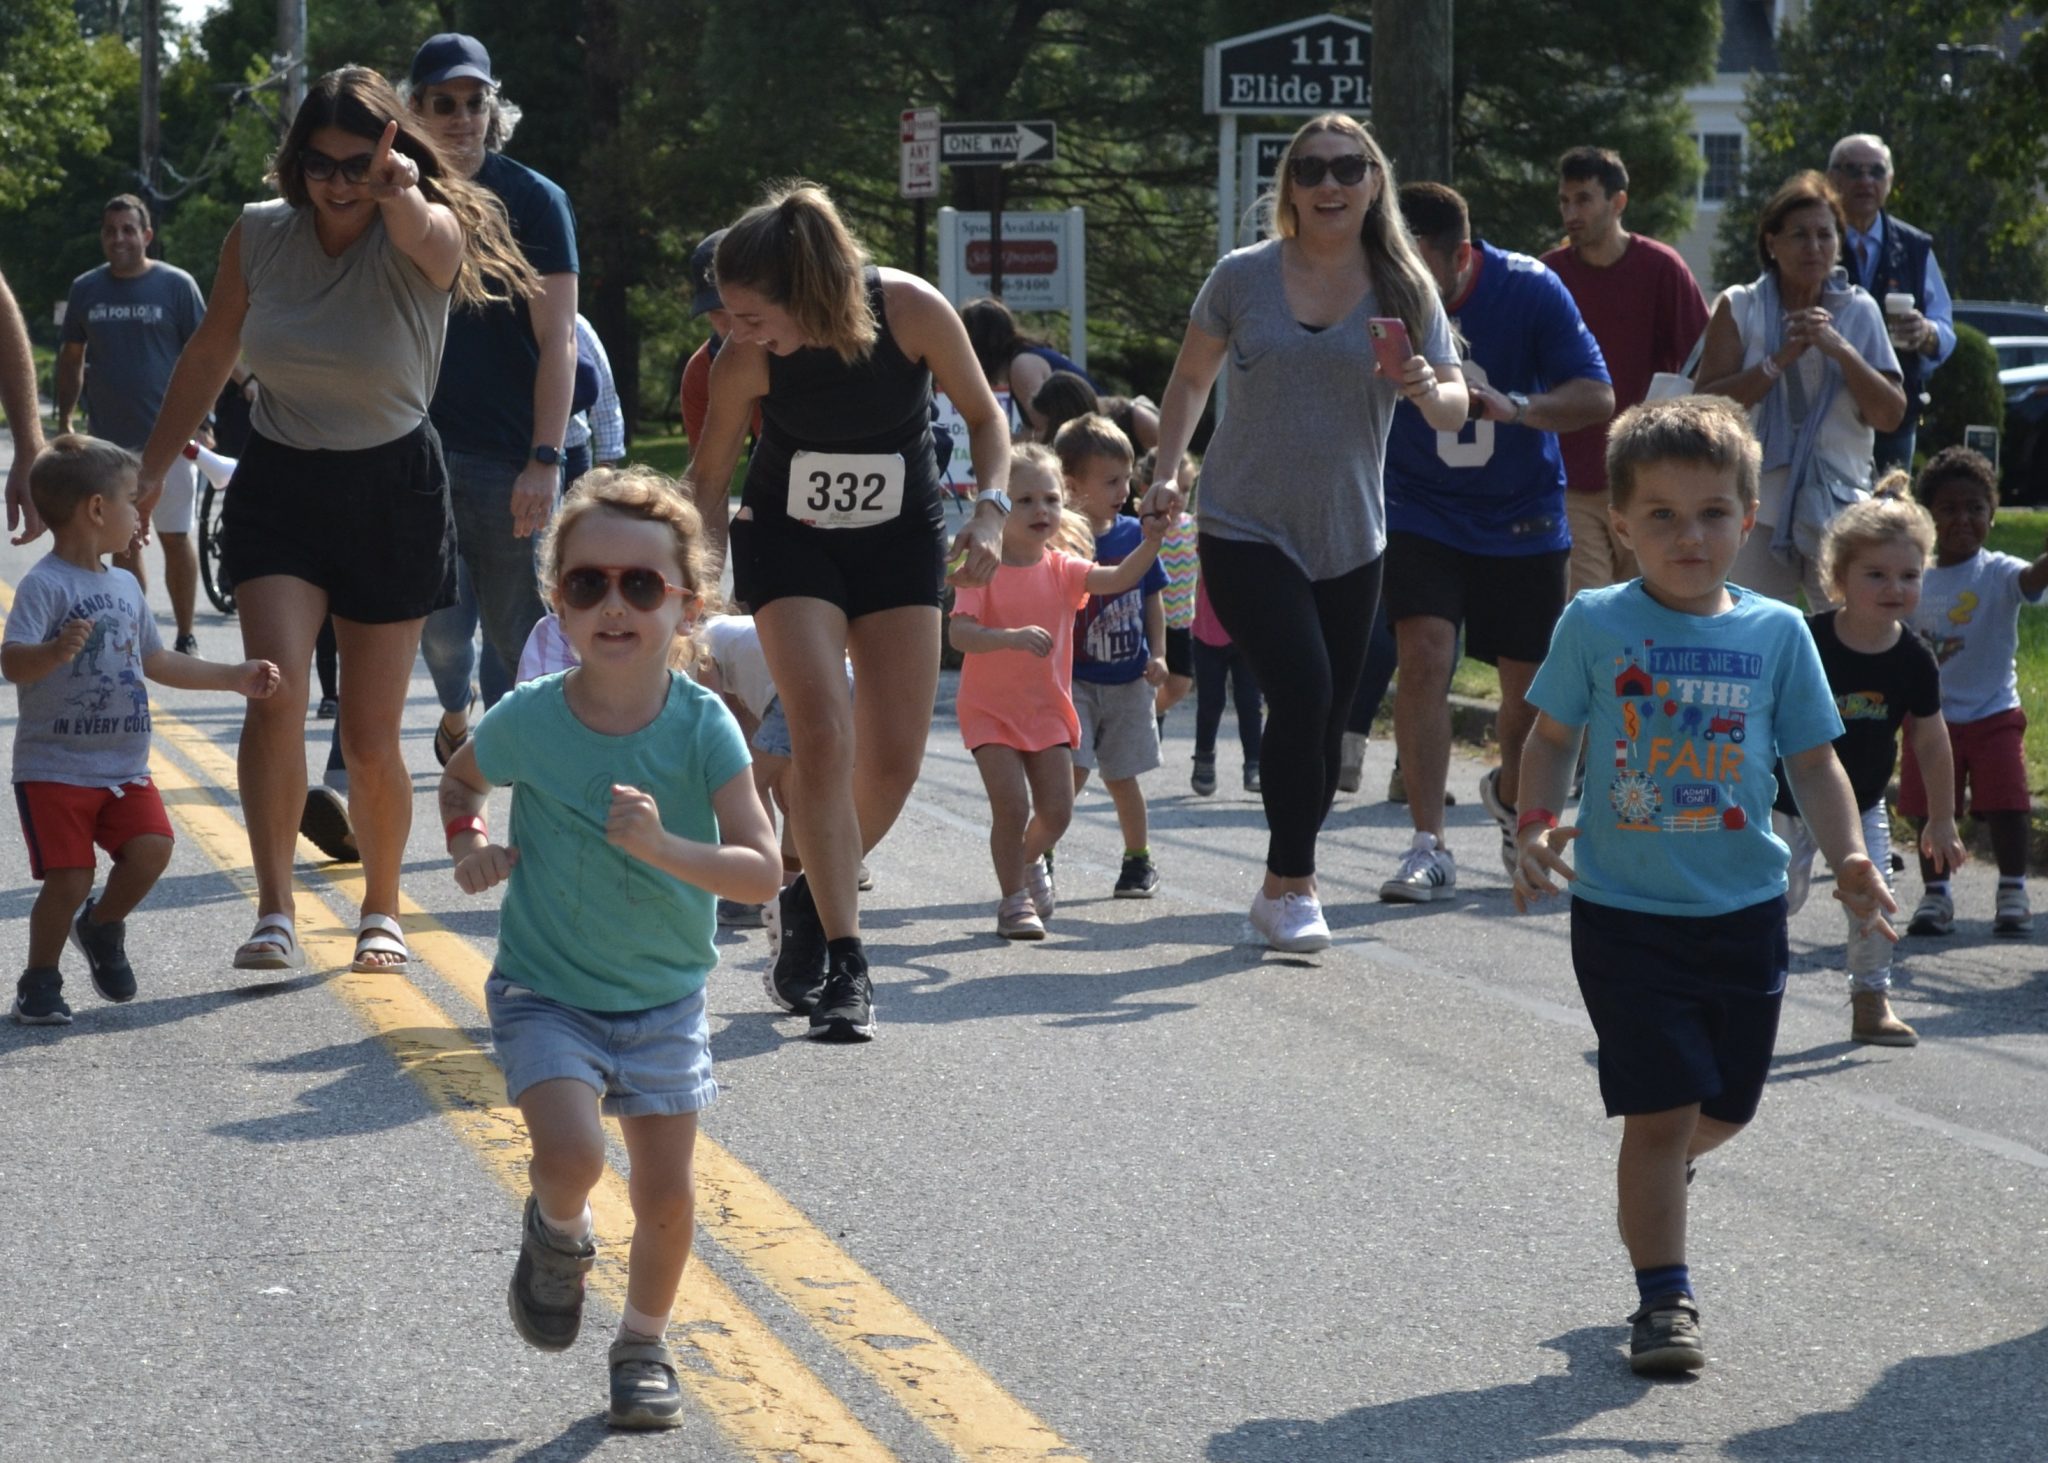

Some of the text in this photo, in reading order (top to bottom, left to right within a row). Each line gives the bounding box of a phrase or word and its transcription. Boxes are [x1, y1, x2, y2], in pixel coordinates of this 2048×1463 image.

[1291, 36, 1364, 65] 111
[1229, 74, 1372, 104] Elide Pl
[910, 145, 930, 158] ANY
[950, 135, 1024, 150] ONE WAY
[962, 221, 992, 237] Spac
[109, 306, 130, 319] FOR
[807, 471, 887, 512] 332
[1653, 651, 1762, 676] TAKE ME TO
[1677, 679, 1750, 708] THE
[53, 718, 69, 735] IN
[74, 717, 119, 735] EVERY
[1648, 737, 1745, 784] FAIR
[1683, 788, 1710, 797] ADMIT
